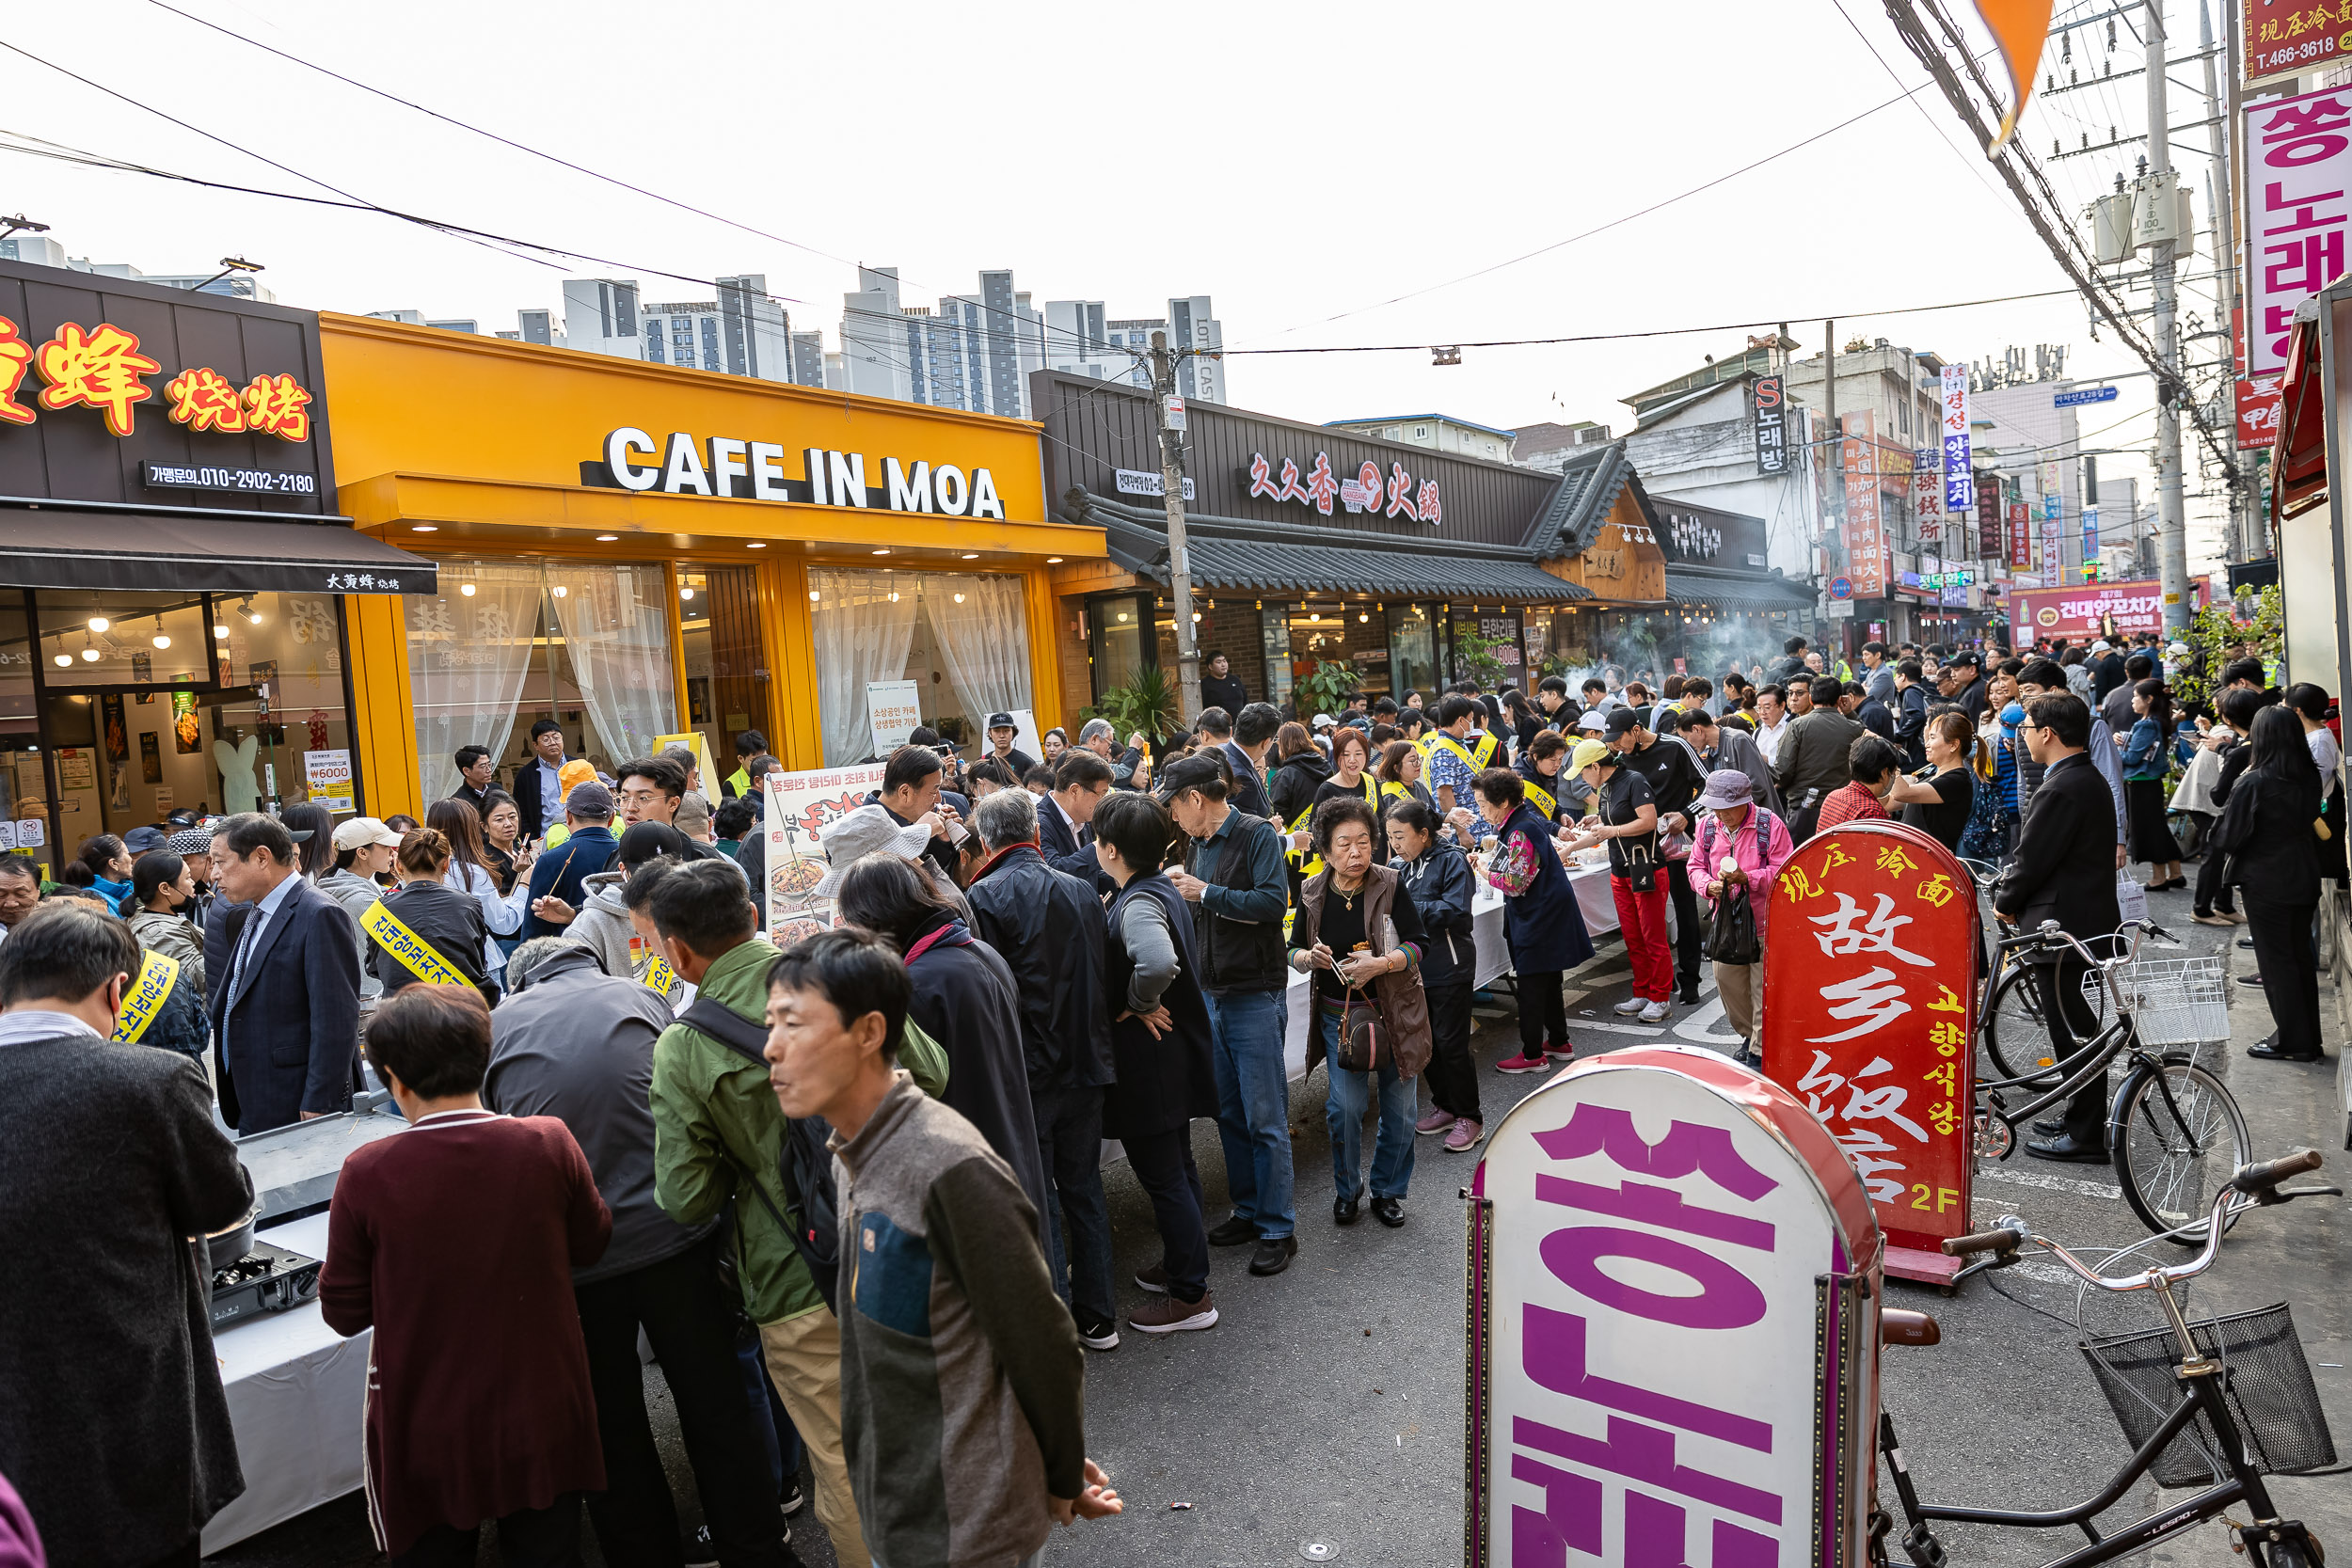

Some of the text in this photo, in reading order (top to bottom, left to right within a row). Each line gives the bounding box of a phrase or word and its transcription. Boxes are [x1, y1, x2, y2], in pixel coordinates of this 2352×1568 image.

[2257, 37, 2334, 70] T.466-3618
[1197, 318, 1211, 363] LOTE
[604, 427, 1006, 520] CAFE IN MOA
[1945, 436, 1972, 504] 양꼬치
[1482, 618, 1517, 639] 무한리필
[873, 705, 916, 718] 소상공인 카페
[904, 717, 917, 727] 기념
[1911, 1182, 1960, 1214] 2F
